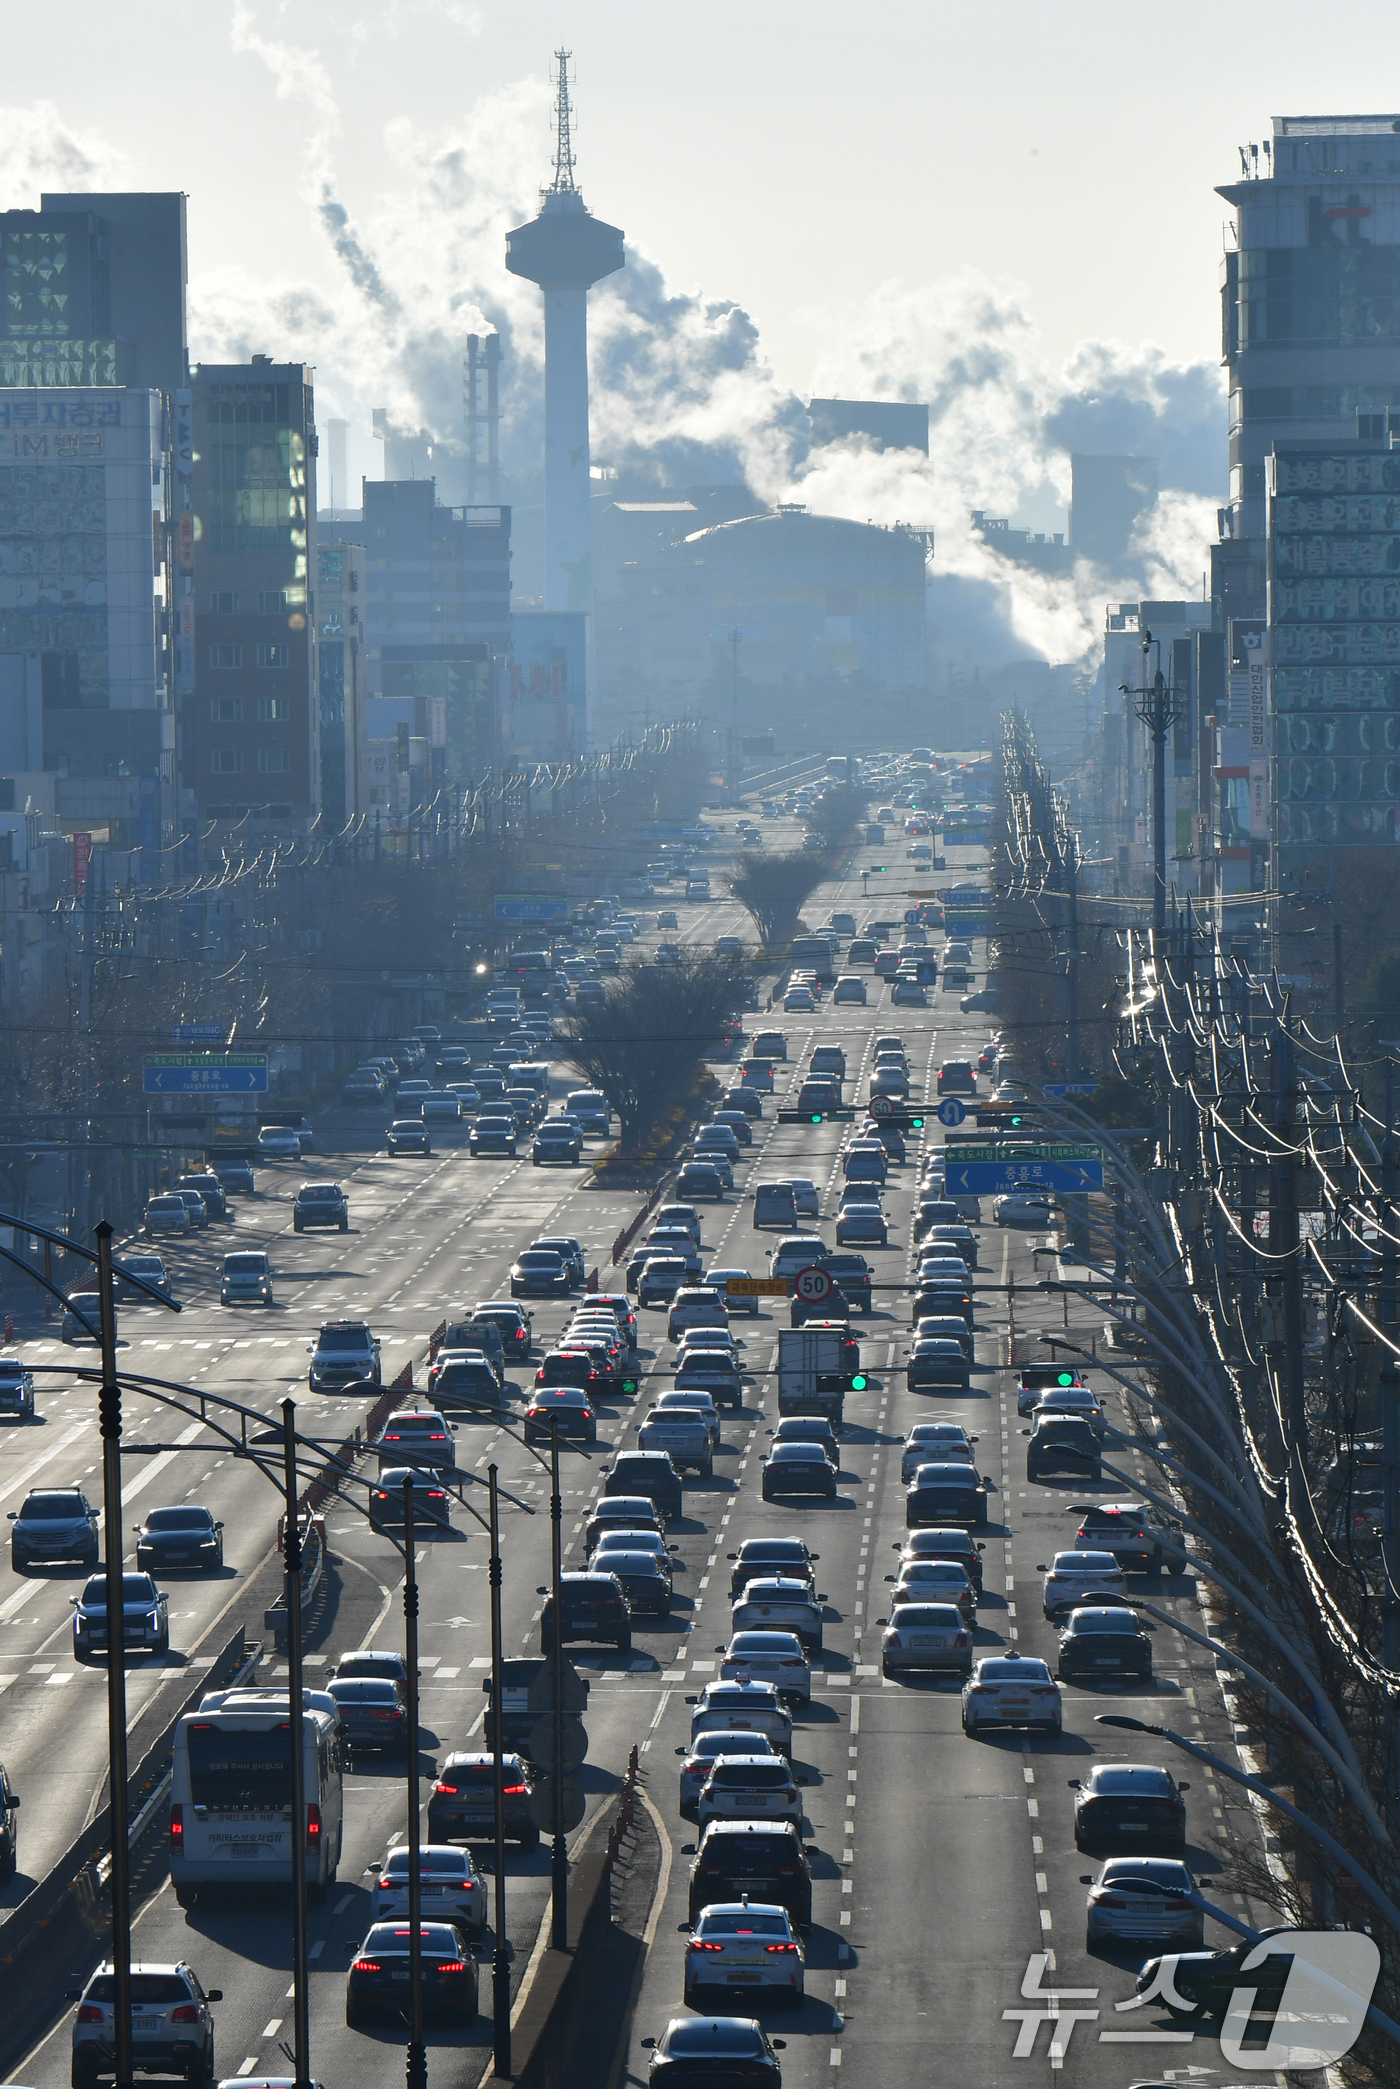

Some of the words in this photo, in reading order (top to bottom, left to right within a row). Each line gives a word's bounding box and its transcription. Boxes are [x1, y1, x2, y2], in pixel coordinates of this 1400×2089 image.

[1308, 195, 1371, 248] kt
[1279, 541, 1381, 571] 재활통증
[183, 604, 192, 635] meritz
[1279, 676, 1379, 706] 두피탈모
[1251, 664, 1264, 746] 대한산업안전협회
[190, 1070, 221, 1083] 중흥로
[874, 1102, 889, 1114] 50
[957, 1150, 993, 1160] 죽도시장
[1005, 1166, 1044, 1181] 중흥로
[732, 1282, 784, 1293] 과속단속장비
[803, 1276, 824, 1293] 50
[252, 1762, 284, 1770] 감사합니다
[218, 1813, 240, 1821] 장애인
[242, 1813, 256, 1821] 보호
[259, 1813, 274, 1821] 차량
[208, 1833, 282, 1842] 카리타스보호작업장
